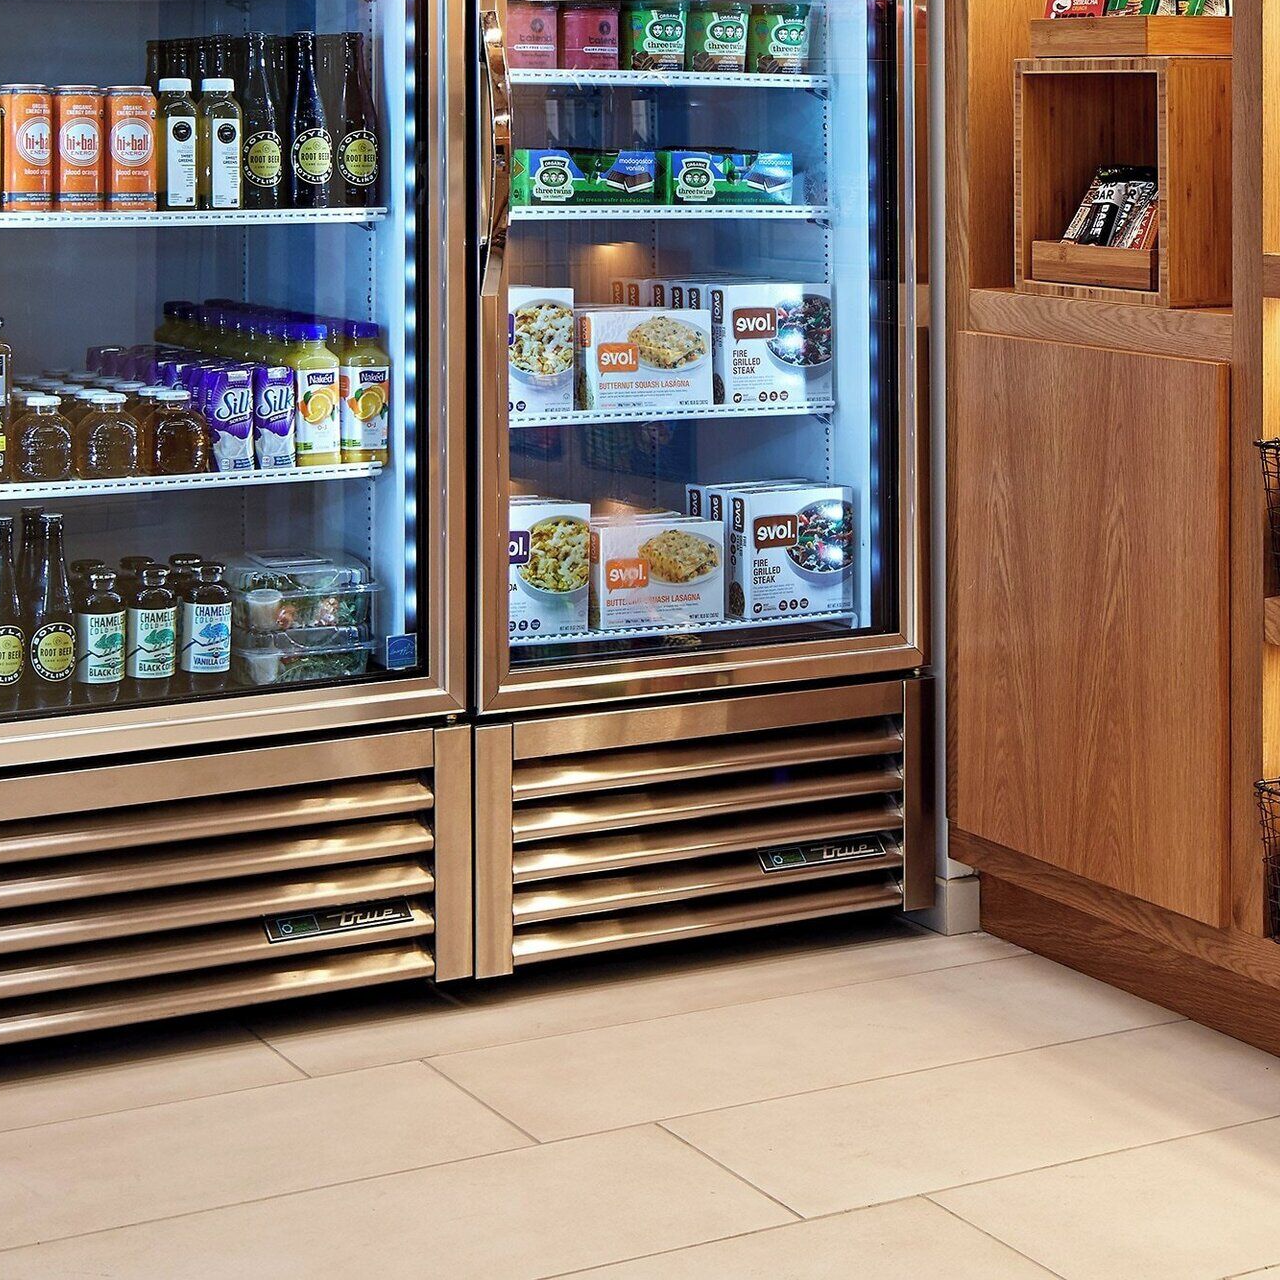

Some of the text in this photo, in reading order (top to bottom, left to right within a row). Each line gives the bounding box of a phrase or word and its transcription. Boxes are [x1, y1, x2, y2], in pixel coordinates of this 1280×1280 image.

[647, 41, 668, 49] three
[708, 42, 729, 50] three
[768, 45, 789, 53] three
[250, 156, 266, 164] ROOT
[301, 153, 330, 161] ROOT BEER
[346, 155, 360, 163] ROOT
[535, 187, 571, 196] three twins
[678, 187, 714, 196] three twins
[1095, 190, 1115, 200] BAR
[736, 316, 775, 332] evol.
[600, 349, 637, 366] evol.
[732, 350, 748, 358] FIRE
[732, 357, 761, 367] GRILLED
[732, 366, 756, 376] STEAK
[599, 381, 633, 389] BUTTERNUT
[634, 380, 660, 388] SQUASH
[216, 390, 253, 419] Silk
[257, 388, 295, 417] Silk
[756, 525, 795, 541] evol.
[753, 559, 769, 568] FIRE
[753, 567, 781, 577] GRILLED
[753, 575, 776, 585] STEAK
[671, 593, 701, 602] LASAGNA
[40, 647, 72, 657] ROOT BEER
[193, 656, 216, 665] VANILLA
[89, 667, 110, 677] BLACK
[139, 663, 159, 672] BLACK
